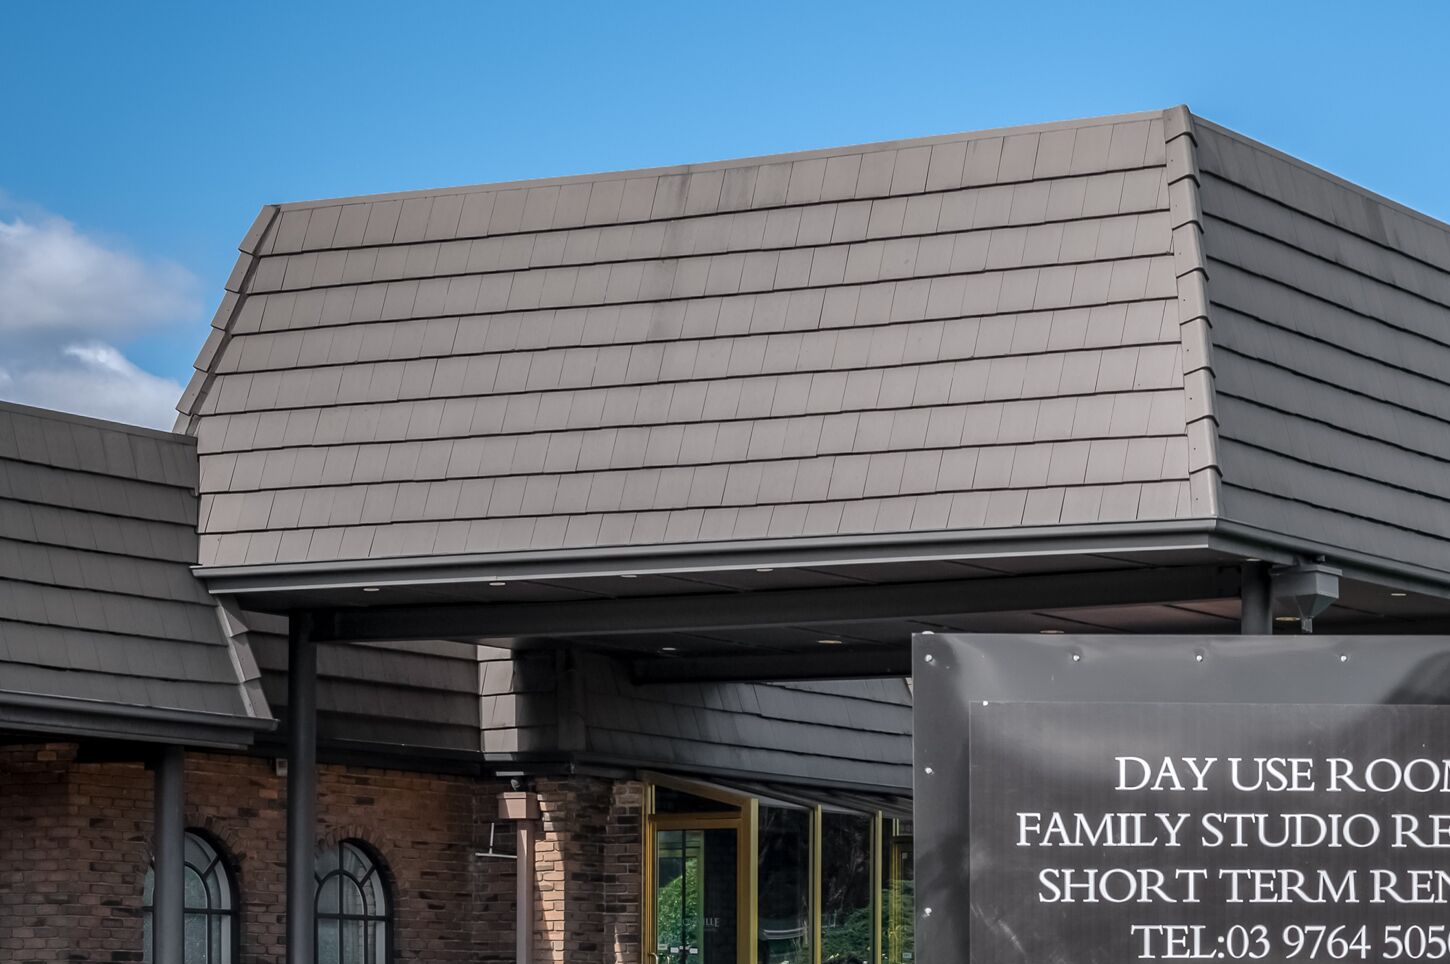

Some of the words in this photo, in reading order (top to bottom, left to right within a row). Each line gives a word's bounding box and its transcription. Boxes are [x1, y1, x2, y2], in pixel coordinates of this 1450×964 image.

[1114, 756, 1218, 792] DAY
[1227, 757, 1316, 792] USE
[1016, 811, 1191, 848] FAMILY
[1201, 812, 1380, 849] STUDIO
[1038, 868, 1208, 904] SHORT
[1218, 868, 1360, 904] TERM
[1130, 924, 1271, 960] TEL:03
[1282, 924, 1372, 960] 9764
